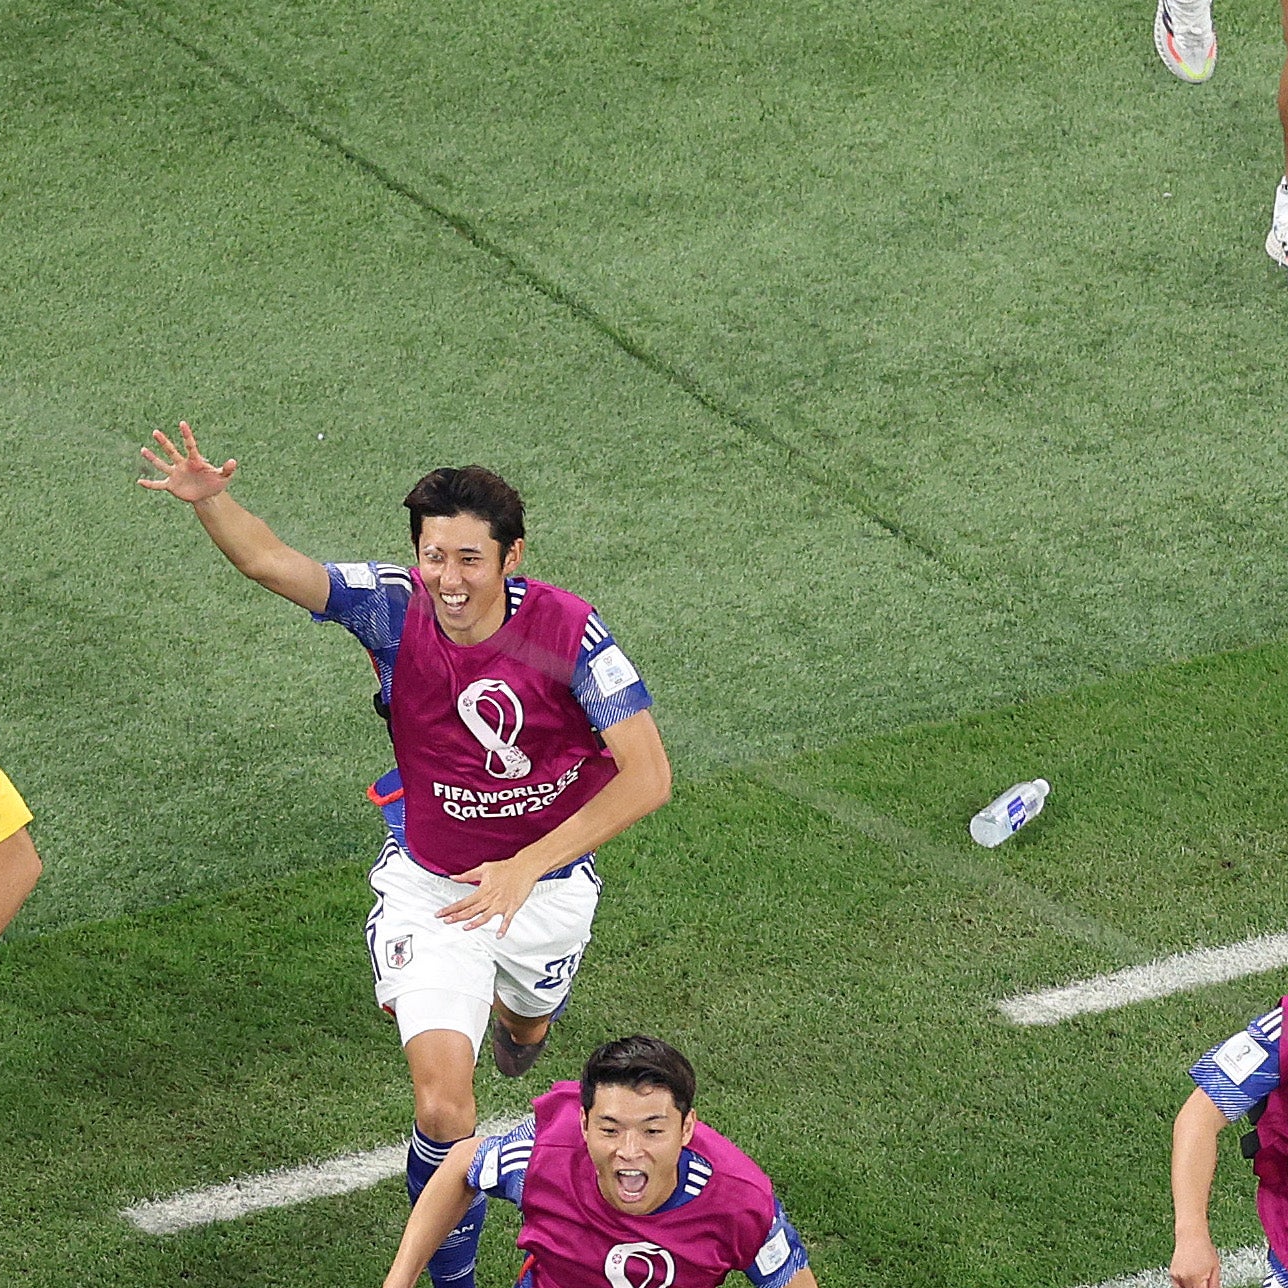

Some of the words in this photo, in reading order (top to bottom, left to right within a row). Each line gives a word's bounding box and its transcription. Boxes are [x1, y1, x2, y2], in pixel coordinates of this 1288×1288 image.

[433, 781, 477, 803] FIFA
[477, 783, 554, 804] WORLD
[534, 953, 576, 990] 2
